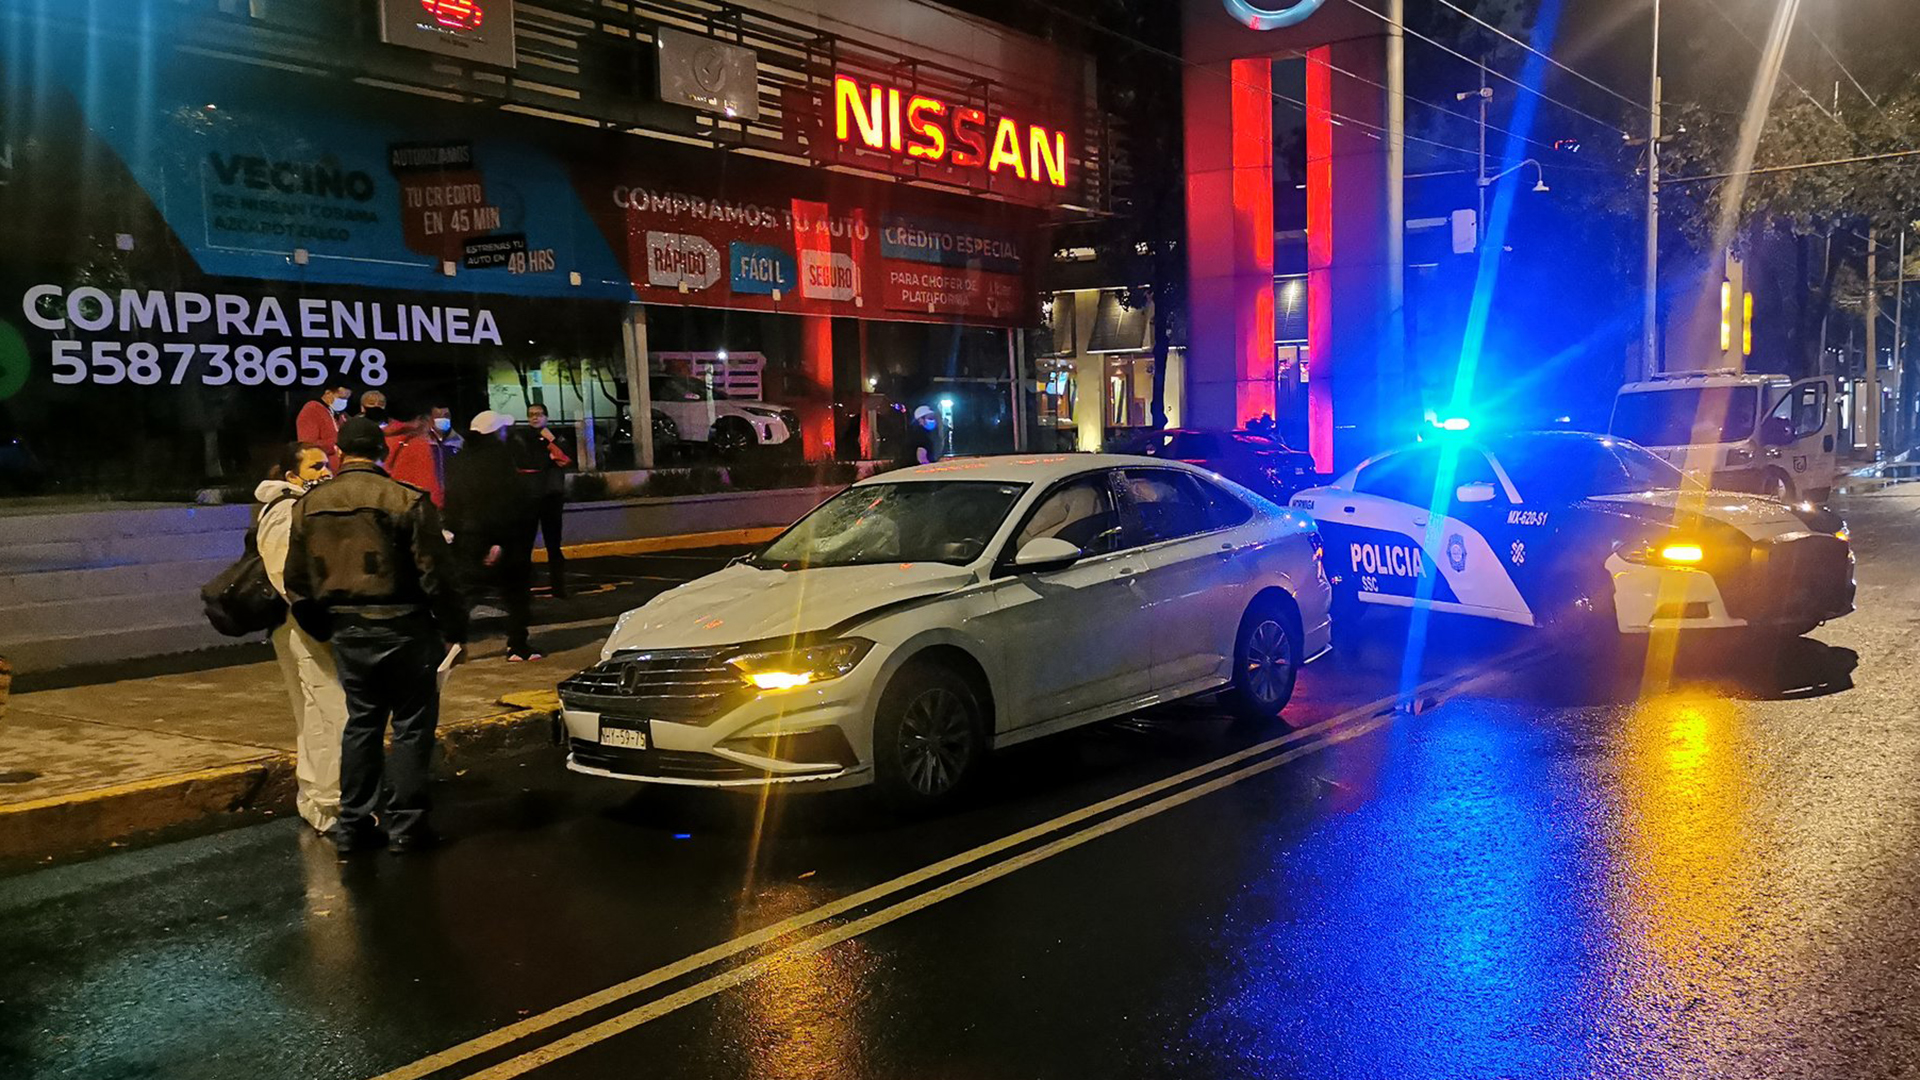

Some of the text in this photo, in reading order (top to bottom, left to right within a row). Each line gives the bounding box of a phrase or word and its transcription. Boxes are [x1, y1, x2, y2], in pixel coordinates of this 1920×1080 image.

[834, 74, 1067, 187] NISSAN
[208, 151, 375, 202] VECINO
[406, 186, 423, 208] TU
[612, 184, 869, 241] COMPRAMOS TU AUTO
[423, 206, 501, 235] EN 45 MIN
[885, 224, 1021, 261] CRÉDITO ESPECIAL
[467, 256, 491, 265] AUTO
[527, 248, 556, 272] HRS
[653, 244, 707, 277] RÁPIDO
[740, 251, 785, 285] FÁCIL
[809, 264, 854, 289] SEGURO
[890, 271, 919, 286] PARA
[921, 274, 963, 291] CHOFER
[22, 284, 503, 347] COMPRA EN LINEA
[51, 340, 388, 386] 5587386578
[1350, 543, 1427, 578] POLICIA
[1361, 575, 1379, 592] SSC
